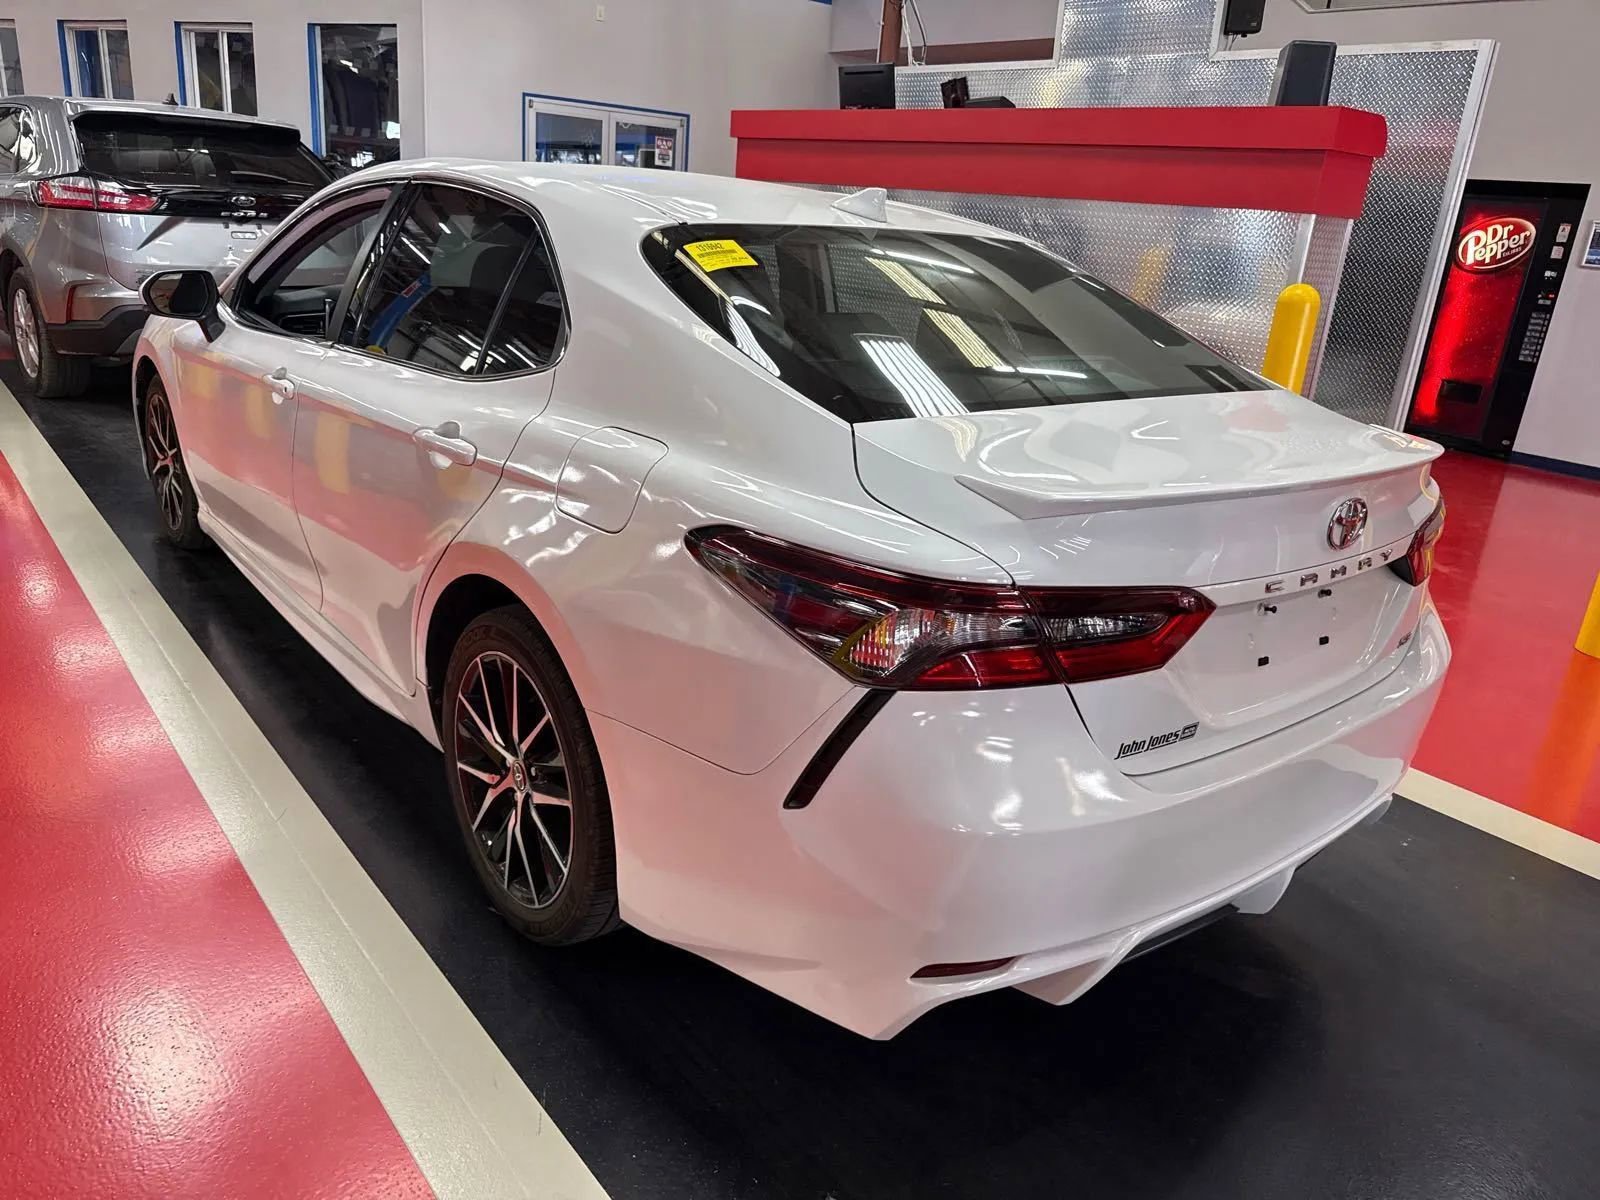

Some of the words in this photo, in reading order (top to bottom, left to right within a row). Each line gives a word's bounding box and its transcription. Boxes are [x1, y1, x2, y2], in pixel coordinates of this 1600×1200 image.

[1459, 230, 1531, 265] Pepper
[1487, 224, 1514, 245] Dr
[1265, 549, 1392, 593] CAMRY
[1114, 742, 1147, 760] John
[1143, 729, 1182, 752] Jones
